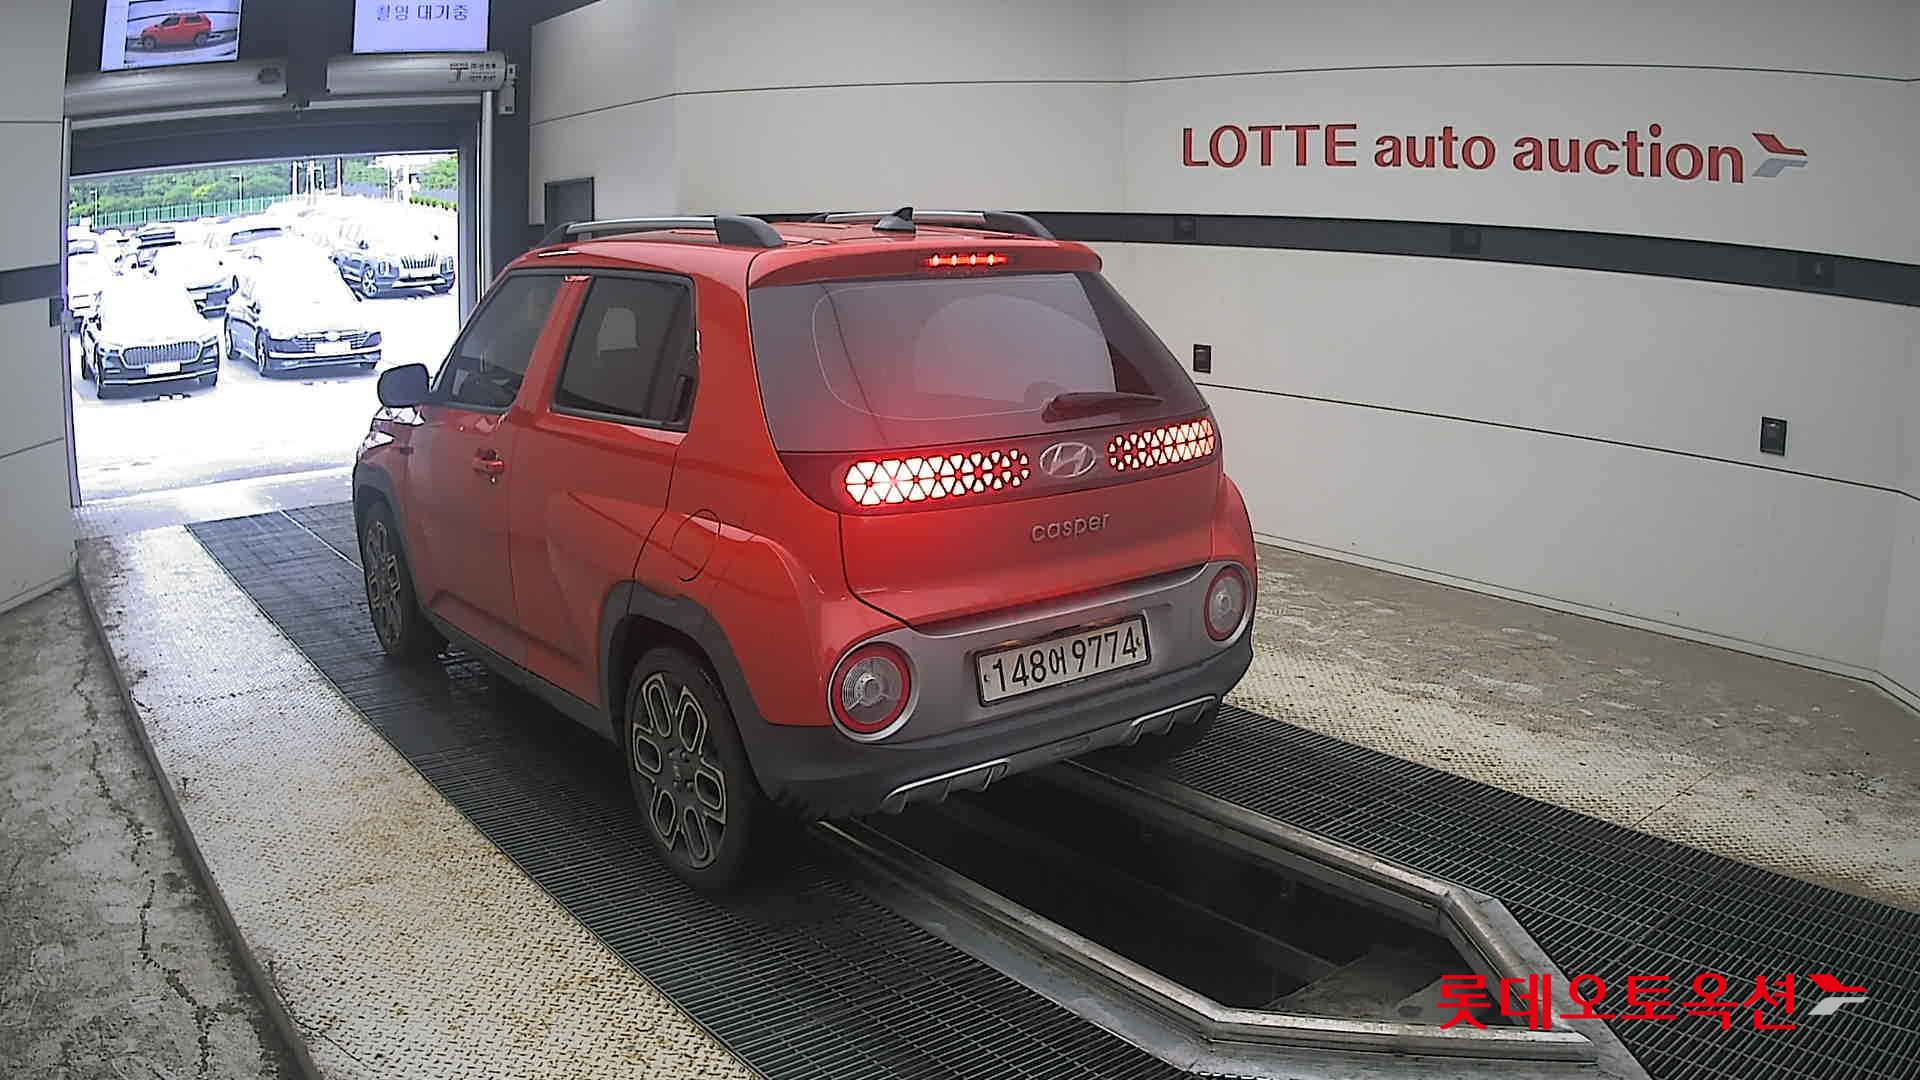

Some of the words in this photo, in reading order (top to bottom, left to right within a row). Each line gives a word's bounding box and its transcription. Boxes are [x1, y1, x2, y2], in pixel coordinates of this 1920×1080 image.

[417, 4, 469, 21] 대기중
[1182, 123, 1358, 169] LOTTE
[1374, 126, 1497, 171] auto
[1512, 123, 1745, 184] auction
[1031, 513, 1111, 542] casper
